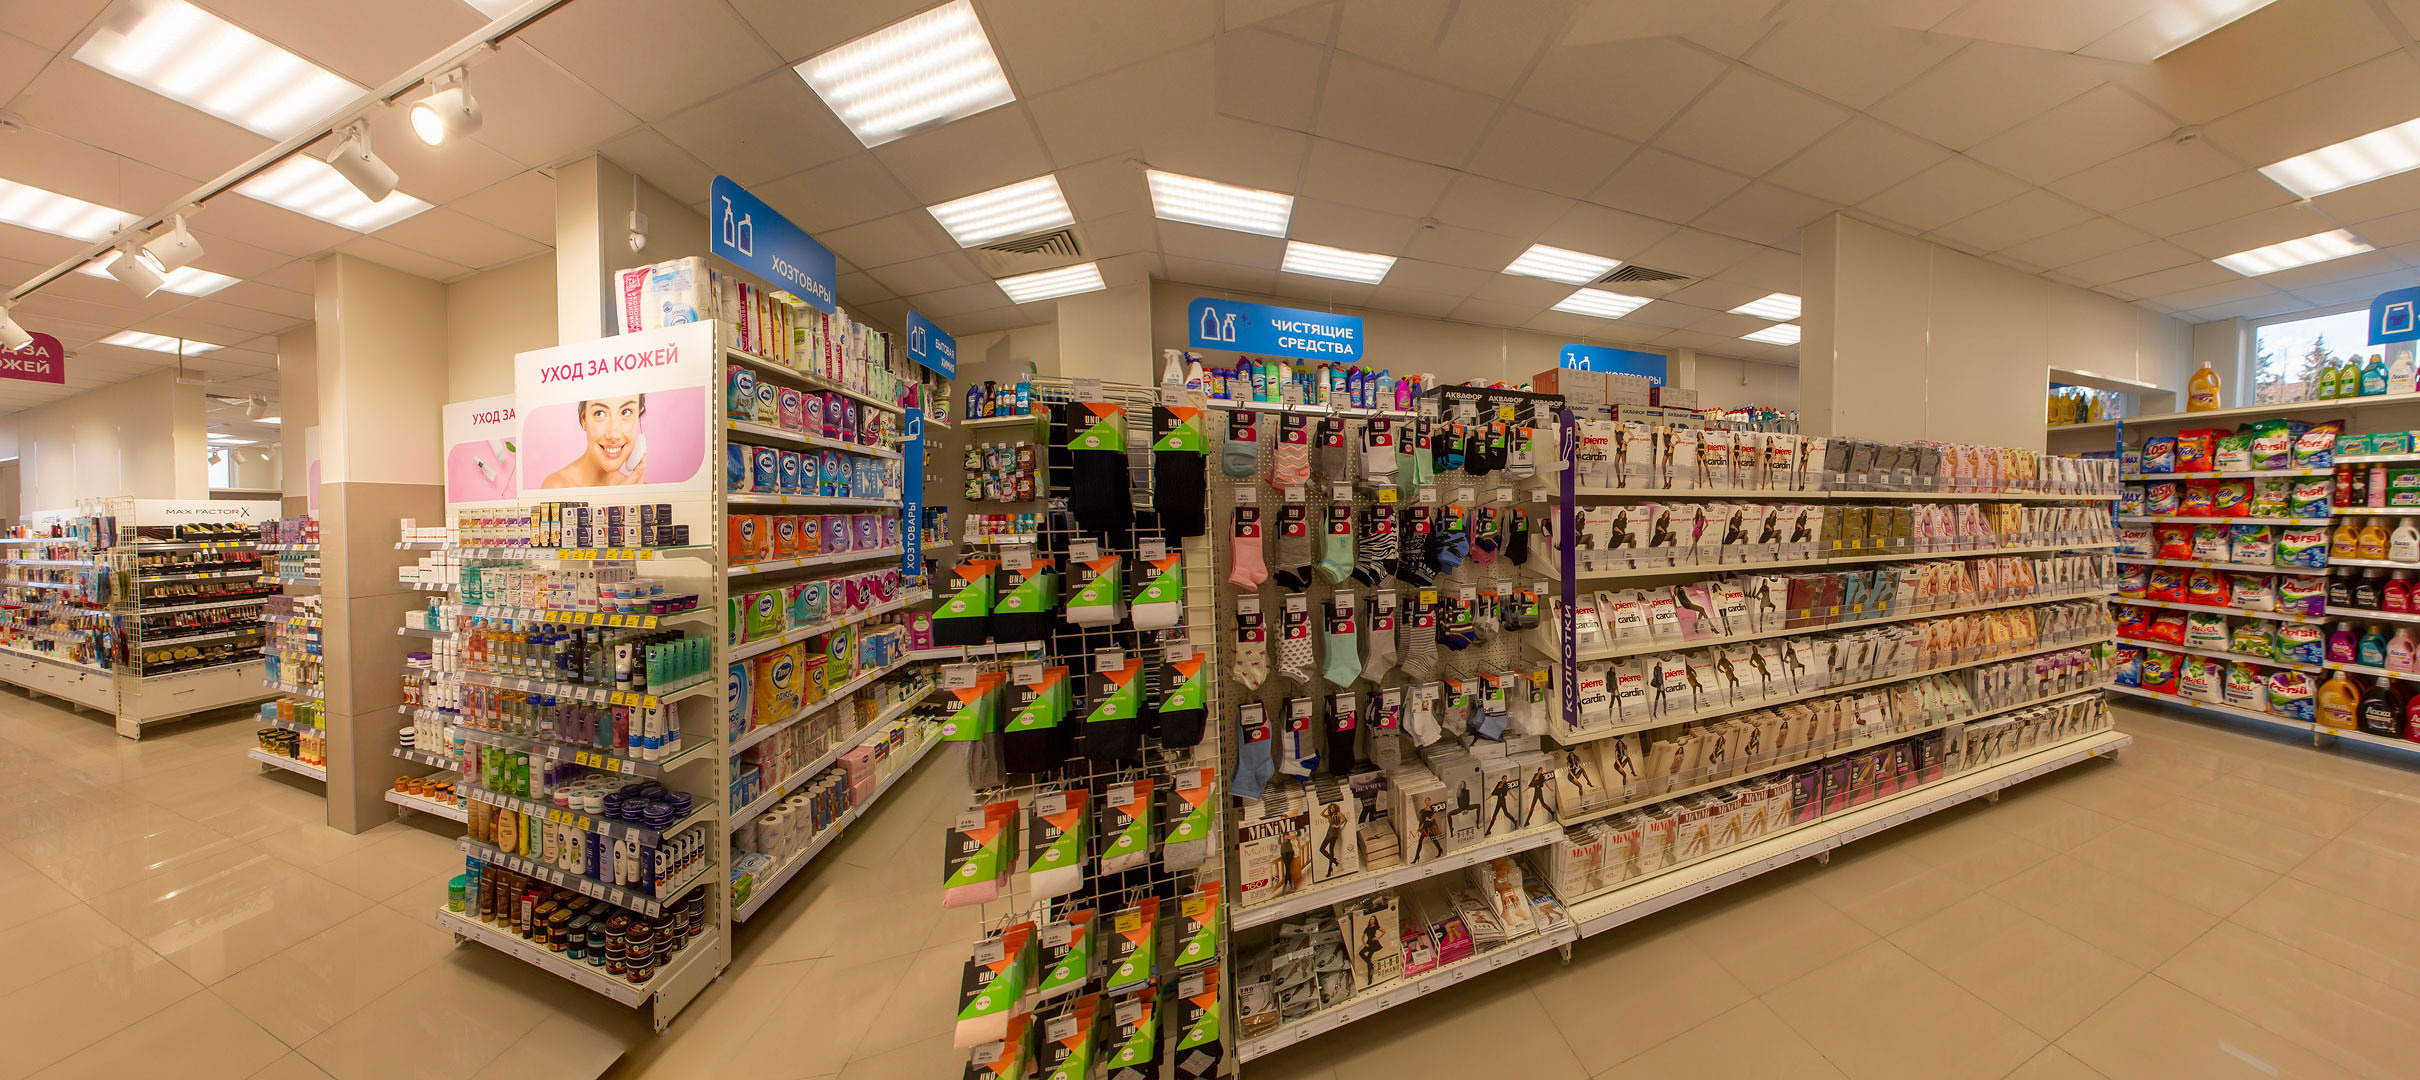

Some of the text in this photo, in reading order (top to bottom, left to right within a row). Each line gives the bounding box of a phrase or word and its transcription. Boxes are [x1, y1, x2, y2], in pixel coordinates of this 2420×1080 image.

[771, 254, 831, 305] ХОЗТОВАРЫ
[1271, 318, 1354, 340] ЧИСТЯЩИЕ
[24, 344, 50, 358] ЗА
[934, 338, 955, 359] БЫТОВАЯ
[1277, 336, 1354, 356] СРЕДСТВА
[540, 342, 679, 384] УХОД ЗА КОЖЕЙ
[940, 359, 955, 374] ХИМИЯ
[1445, 392, 1483, 401] АКВАФОР
[1488, 395, 1524, 404] АКВАФОР
[472, 408, 516, 425] УХОД ЗА
[1583, 435, 1608, 446] pierre
[2254, 441, 2286, 450] Persil
[2297, 439, 2333, 448] Persil
[1707, 442, 1726, 452] pierre
[1742, 444, 1756, 454] pierr
[1774, 446, 1792, 456] pierre
[2178, 447, 2196, 456] Tide
[1582, 452, 1606, 462] cardin
[1708, 457, 1726, 466] cardin
[1772, 460, 1790, 470] cardin
[2297, 486, 2324, 496] Persil
[907, 501, 917, 570] ХОЗТОВАРЫ
[2284, 533, 2322, 544] Persil
[1082, 570, 1097, 579] UNO
[1147, 568, 1161, 576] UNO
[950, 579, 968, 588] UNO
[1009, 575, 1024, 584] UNO
[2151, 574, 2172, 584] Tide
[2190, 578, 2212, 590] Tide
[2282, 582, 2324, 593] Persil
[1724, 591, 1743, 601] pierre
[1614, 600, 1636, 611] pierre
[1652, 598, 1672, 608] pierre
[1728, 604, 1746, 612] cardin
[1618, 614, 1640, 624] cardin
[1656, 610, 1678, 620] cardin
[2280, 627, 2318, 638] Persil
[1564, 604, 1574, 713] КОЛГОТКИ
[776, 666, 792, 678] Zewa
[2144, 664, 2162, 672] Tide
[1618, 673, 1642, 686] pierre
[1664, 668, 1684, 680] pierre
[1580, 678, 1604, 692] pierre
[2182, 676, 2208, 686] ARIEL
[1104, 684, 1118, 692] UNO
[1665, 682, 1686, 693] cardin
[2228, 682, 2253, 692] ARIEL
[2270, 682, 2308, 694] Persil
[1022, 692, 1037, 700] UNO
[1582, 693, 1606, 704] cardin
[1620, 688, 1644, 698] cardin
[947, 701, 964, 710] UNO
[2366, 706, 2392, 717] Ласка
[1180, 802, 1194, 812] UNO
[1117, 814, 1132, 824] UNO
[1248, 819, 1296, 840] MiNiMi
[1650, 818, 1676, 832] MiNiMi
[1046, 827, 1062, 838] UNO
[1612, 830, 1640, 844] MiNiMi
[963, 840, 980, 850] UNO
[1572, 842, 1602, 858] MiNiMi
[1188, 920, 1200, 931] UNO
[1054, 944, 1070, 956] UNO
[1122, 940, 1136, 952] UNO
[978, 971, 995, 982] UNO
[1122, 1025, 1136, 1036] UNO
[1056, 1048, 1070, 1058] UNO
